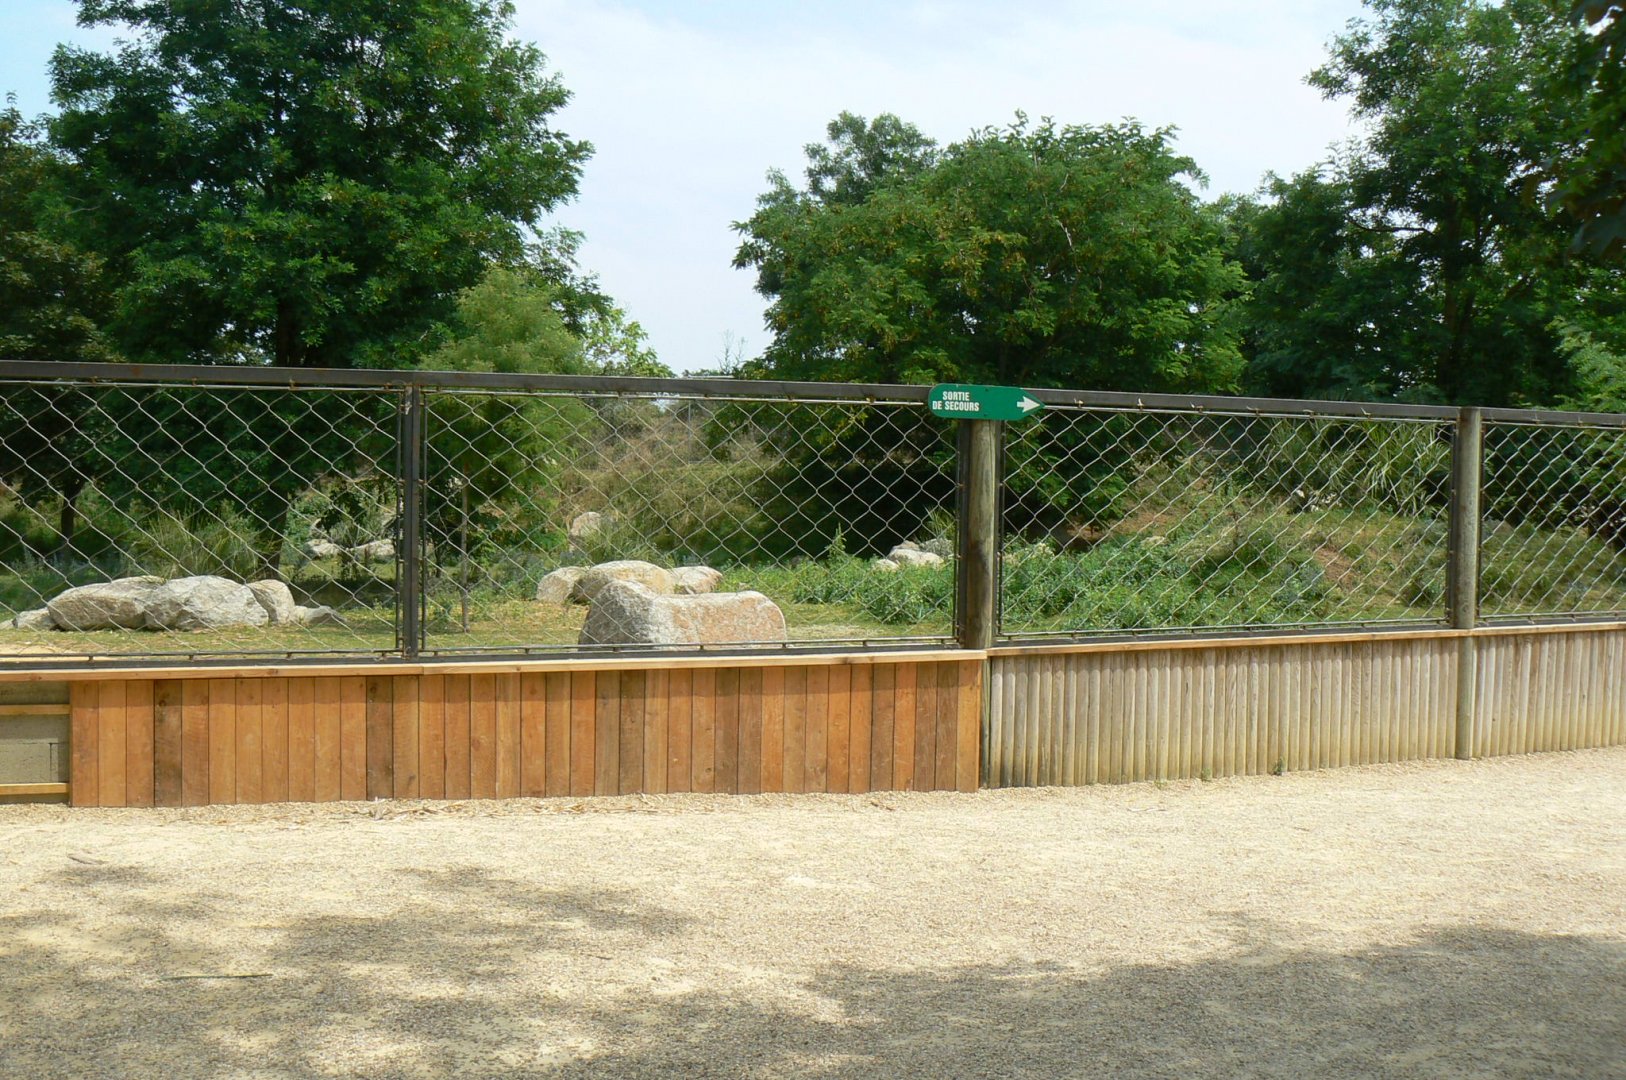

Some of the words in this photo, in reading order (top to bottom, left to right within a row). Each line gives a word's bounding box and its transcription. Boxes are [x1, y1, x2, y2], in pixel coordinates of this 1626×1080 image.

[942, 391, 970, 401] SORTIE
[932, 400, 943, 410] DE
[944, 401, 980, 412] SECOURS
